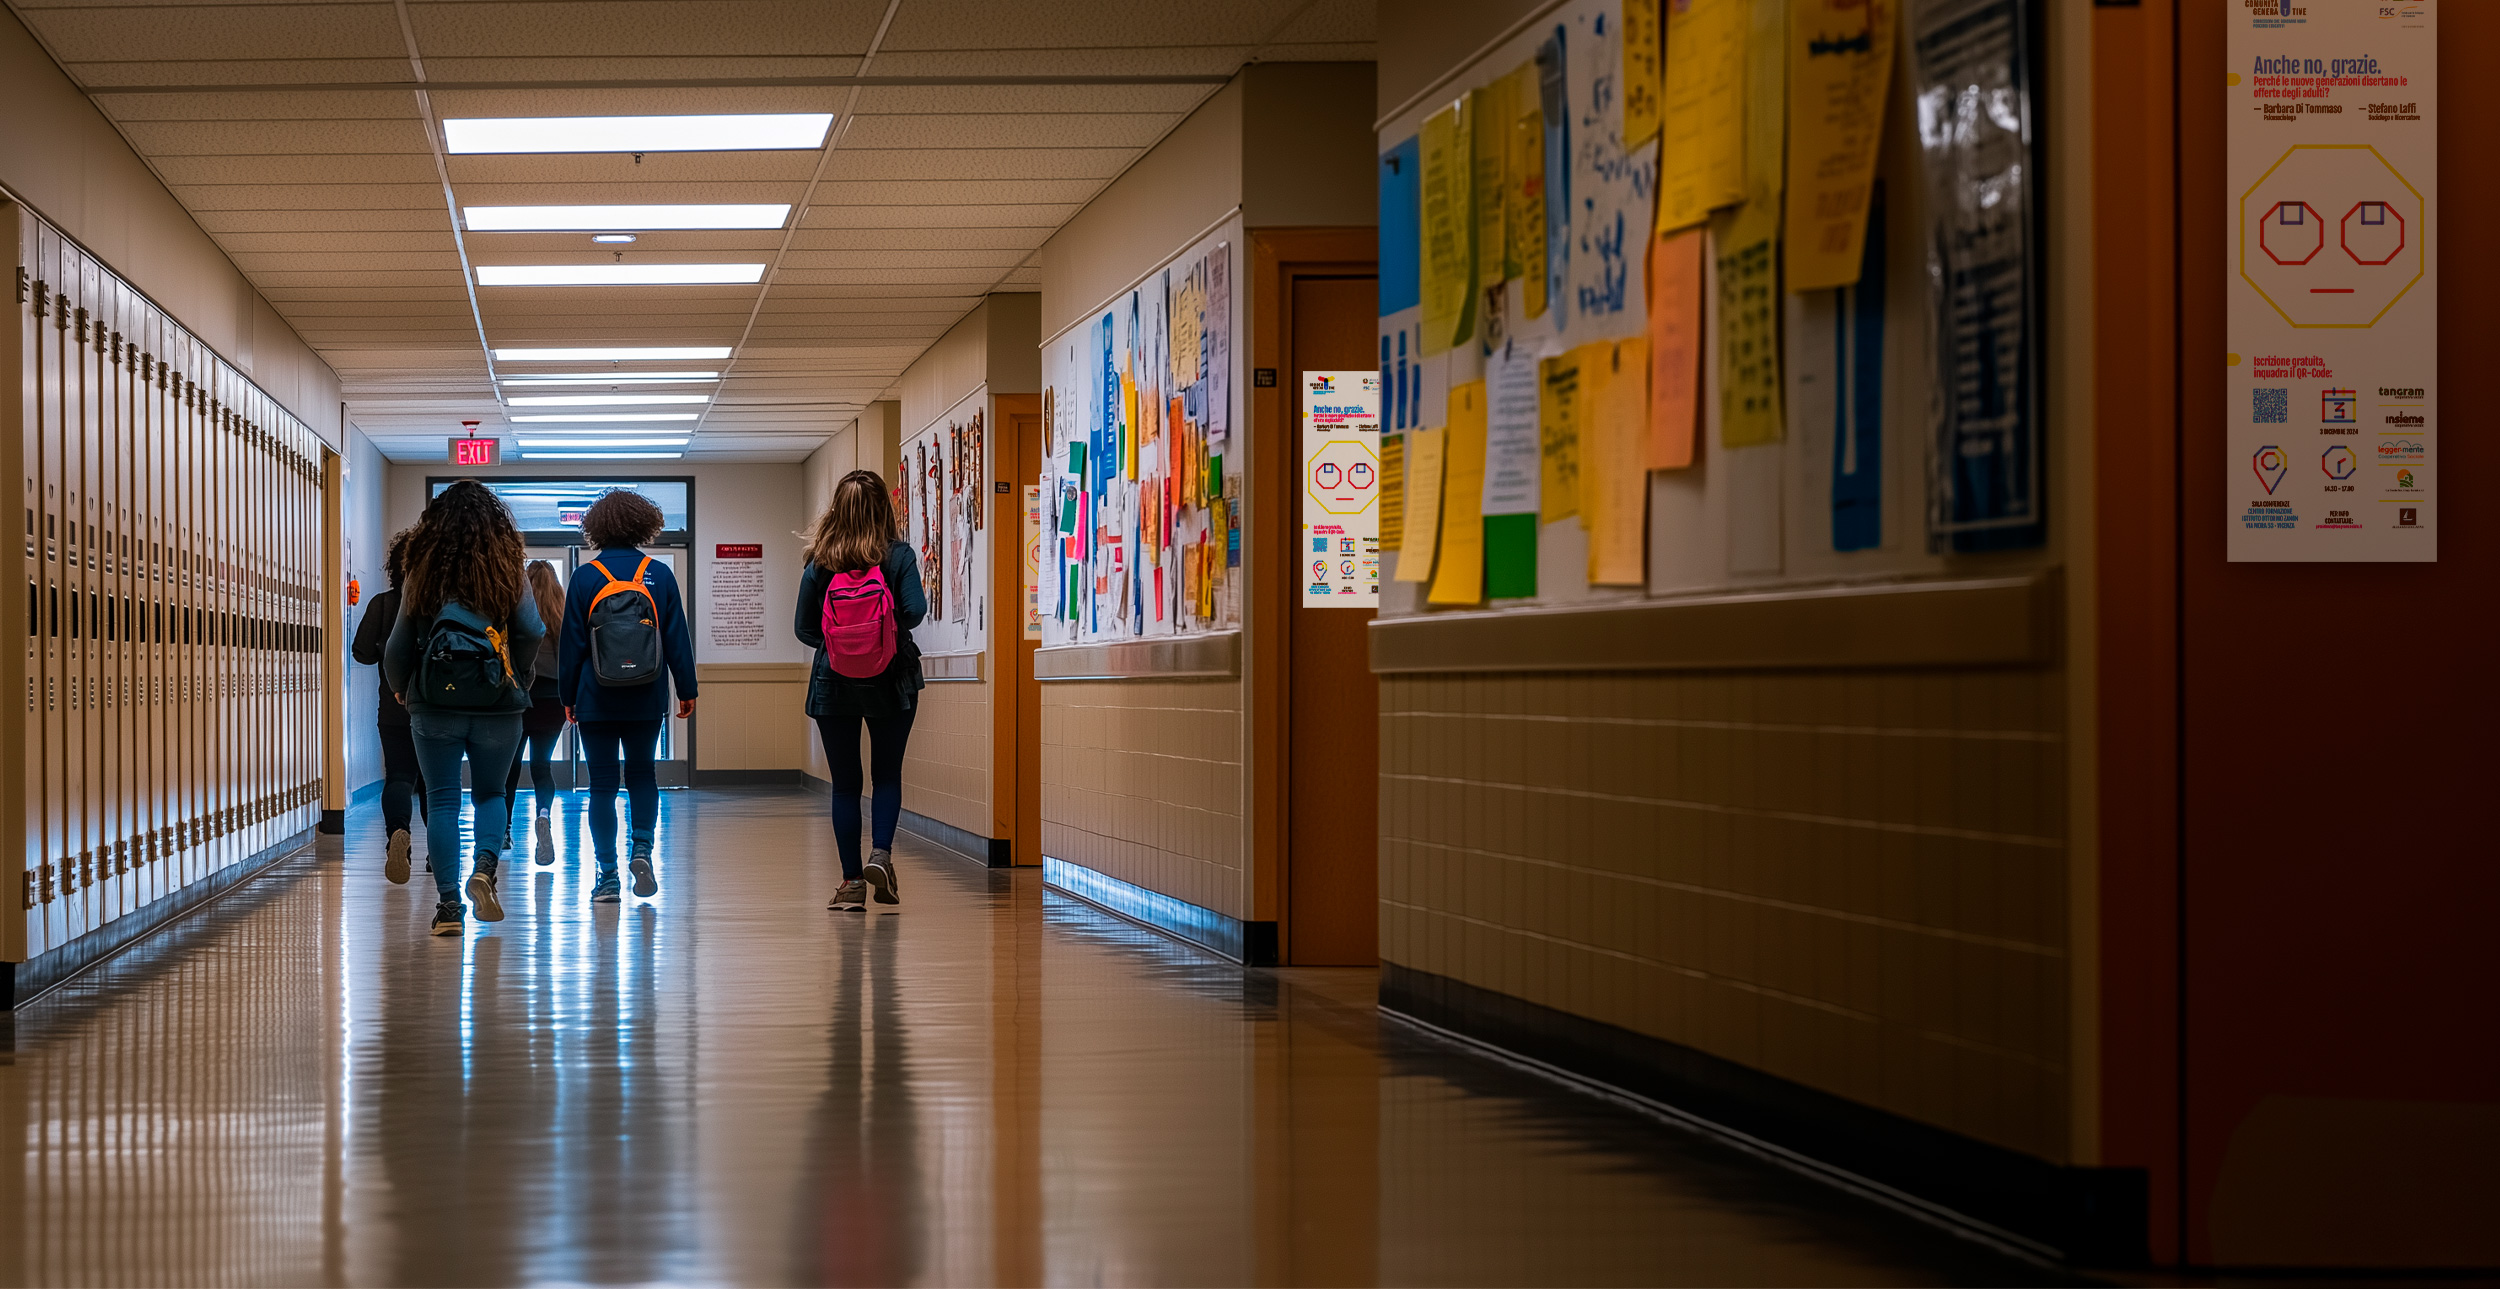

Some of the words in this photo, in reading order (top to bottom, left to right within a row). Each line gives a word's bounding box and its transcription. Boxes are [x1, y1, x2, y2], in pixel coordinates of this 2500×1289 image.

[2379, 7, 2395, 16] FSC
[2254, 55, 2300, 75] Anche
[2303, 58, 2328, 78] no,
[2331, 54, 2382, 78] grazie.
[2253, 75, 2281, 87] Perché
[2282, 75, 2290, 87] le
[2291, 77, 2314, 87] nuove
[2315, 75, 2361, 88] generazioni
[2361, 75, 2399, 87] disertano
[2400, 75, 2408, 87] le
[2253, 87, 2281, 98] offerte
[2281, 87, 2301, 100] degli
[2302, 87, 2330, 98] adulti?
[2263, 103, 2295, 114] Barbara
[2295, 103, 2304, 114] Di
[2305, 103, 2343, 114] Tommaso
[2368, 103, 2398, 114] Stefano
[2399, 103, 2417, 114] Laffi
[2253, 355, 2291, 367] Iscrizione
[2291, 355, 2326, 369] gratuita,
[2253, 367, 2288, 380] inquadra
[2289, 367, 2296, 378] il
[2297, 367, 2333, 379] QR-Code:
[2378, 386, 2425, 396] tangram
[1313, 405, 1332, 414] Anche
[1333, 406, 1344, 415] no,
[1343, 404, 1365, 416] grazie.
[457, 439, 495, 466] EXIT
